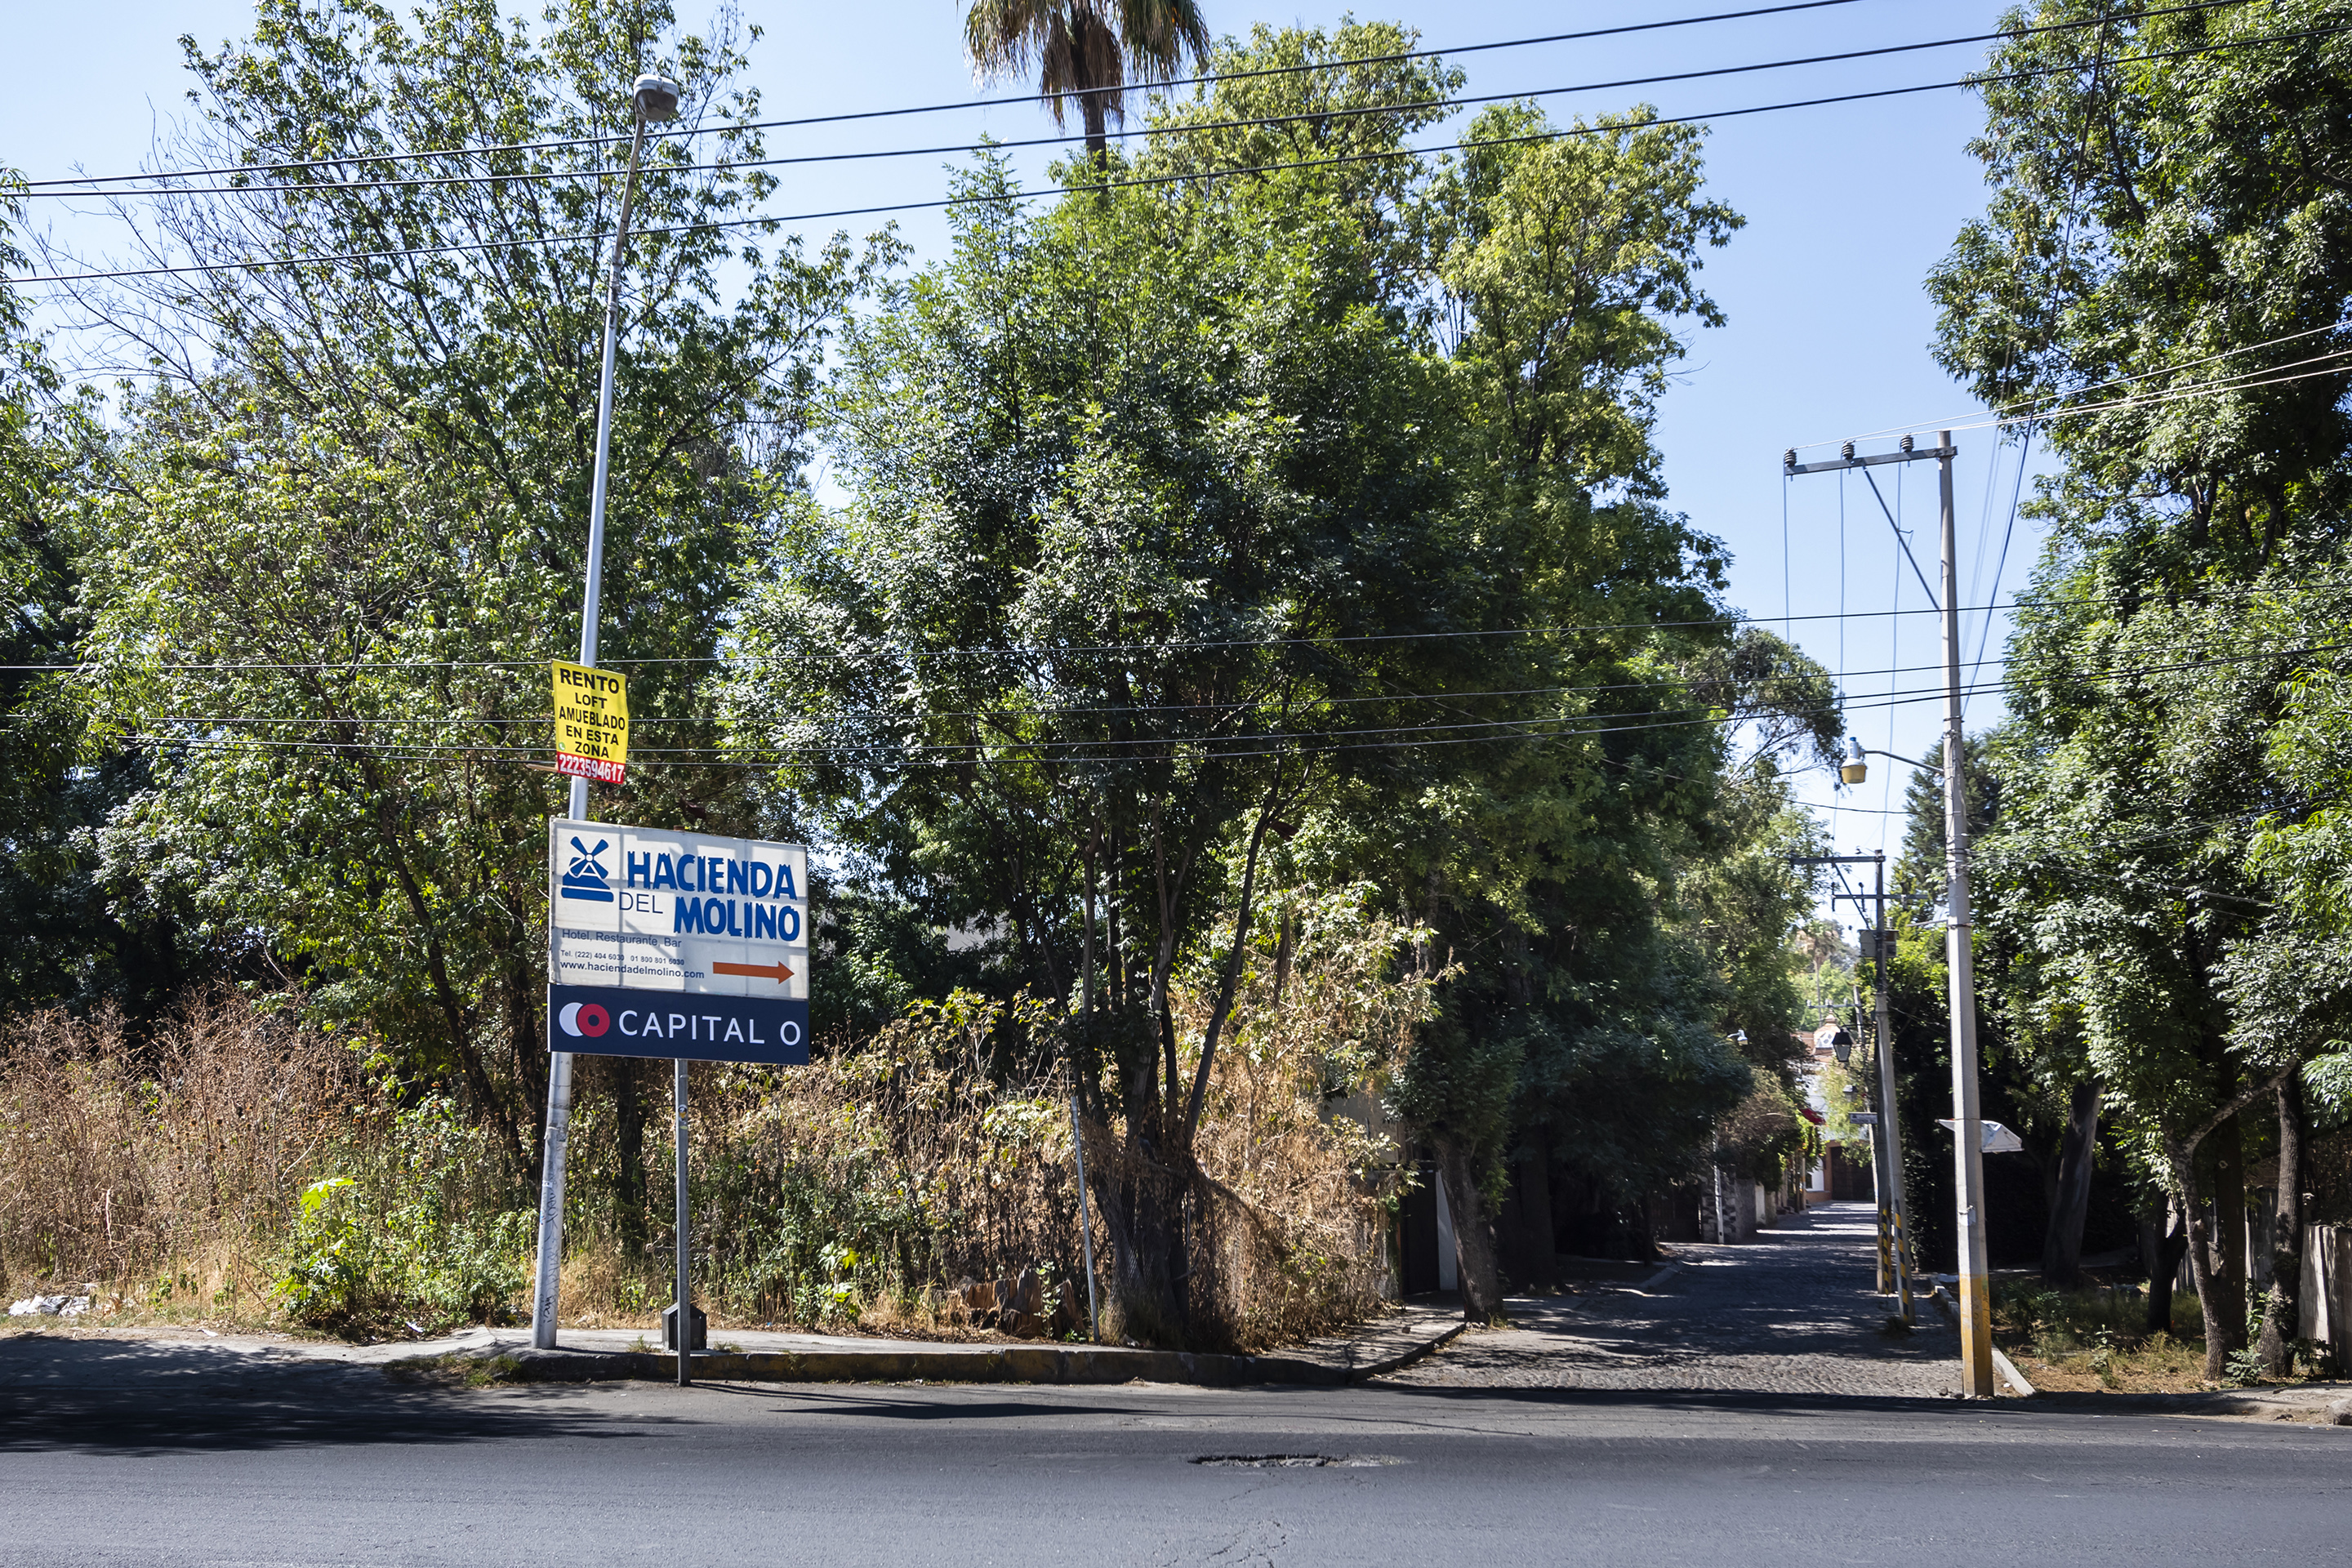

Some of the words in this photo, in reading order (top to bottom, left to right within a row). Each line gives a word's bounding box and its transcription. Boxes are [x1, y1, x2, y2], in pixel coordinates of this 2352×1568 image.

[559, 668, 619, 693] RENTO
[575, 693, 607, 709] LOFT
[559, 706, 626, 731] AMUEBLADO
[565, 725, 582, 738] EN
[586, 729, 619, 746] ESTA
[575, 742, 609, 758] ZONA
[559, 754, 624, 782] 2223594617
[627, 851, 798, 901] HACIENDA
[618, 892, 663, 914] DEL
[674, 897, 800, 942] MOLINO
[562, 929, 592, 942] Hotel,
[595, 931, 660, 947] Restaurante,
[664, 937, 682, 947] Bar
[574, 951, 592, 960] (222)
[560, 961, 705, 978] www.haciendadelmolino.com
[618, 1010, 765, 1045] CAPITAL
[780, 1021, 801, 1046] O
